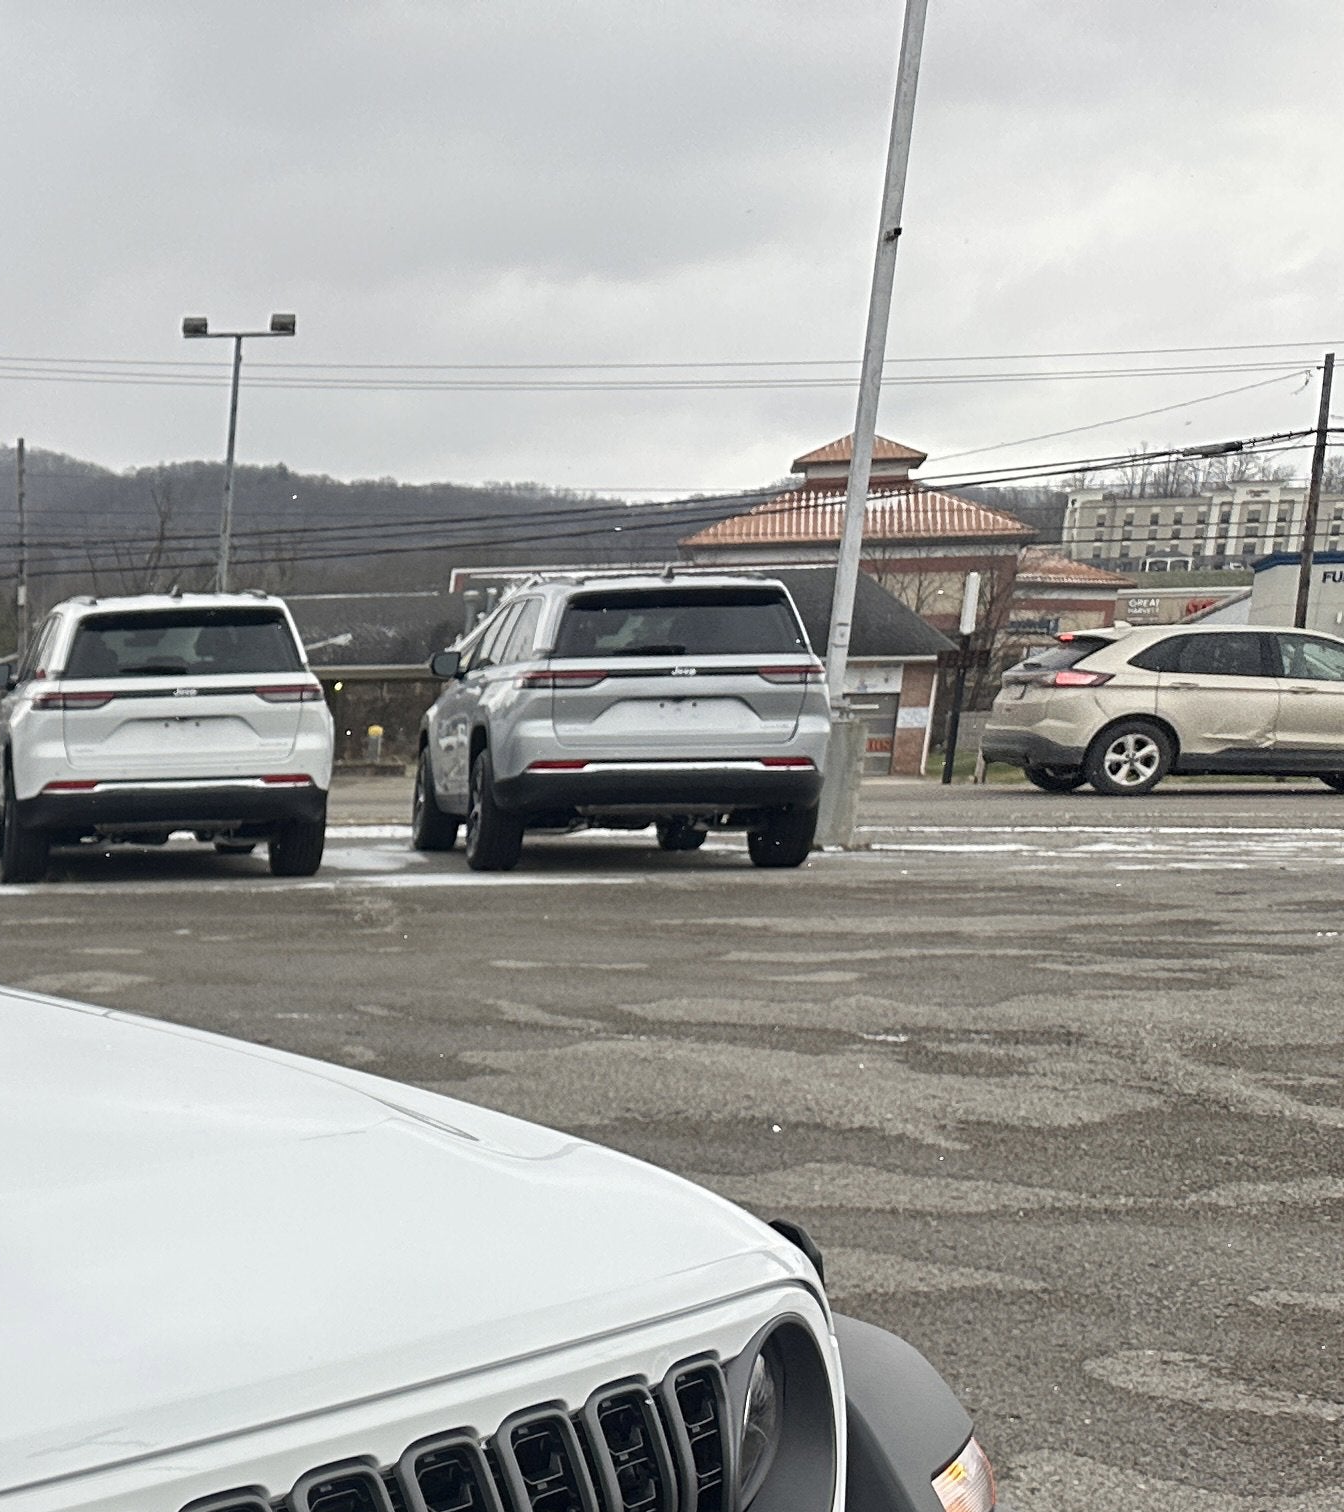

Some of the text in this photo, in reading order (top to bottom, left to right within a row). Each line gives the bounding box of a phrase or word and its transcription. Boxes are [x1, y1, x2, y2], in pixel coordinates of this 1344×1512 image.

[1322, 570, 1344, 584] FU
[1128, 598, 1160, 608] GREAT
[671, 666, 697, 676] Jeep
